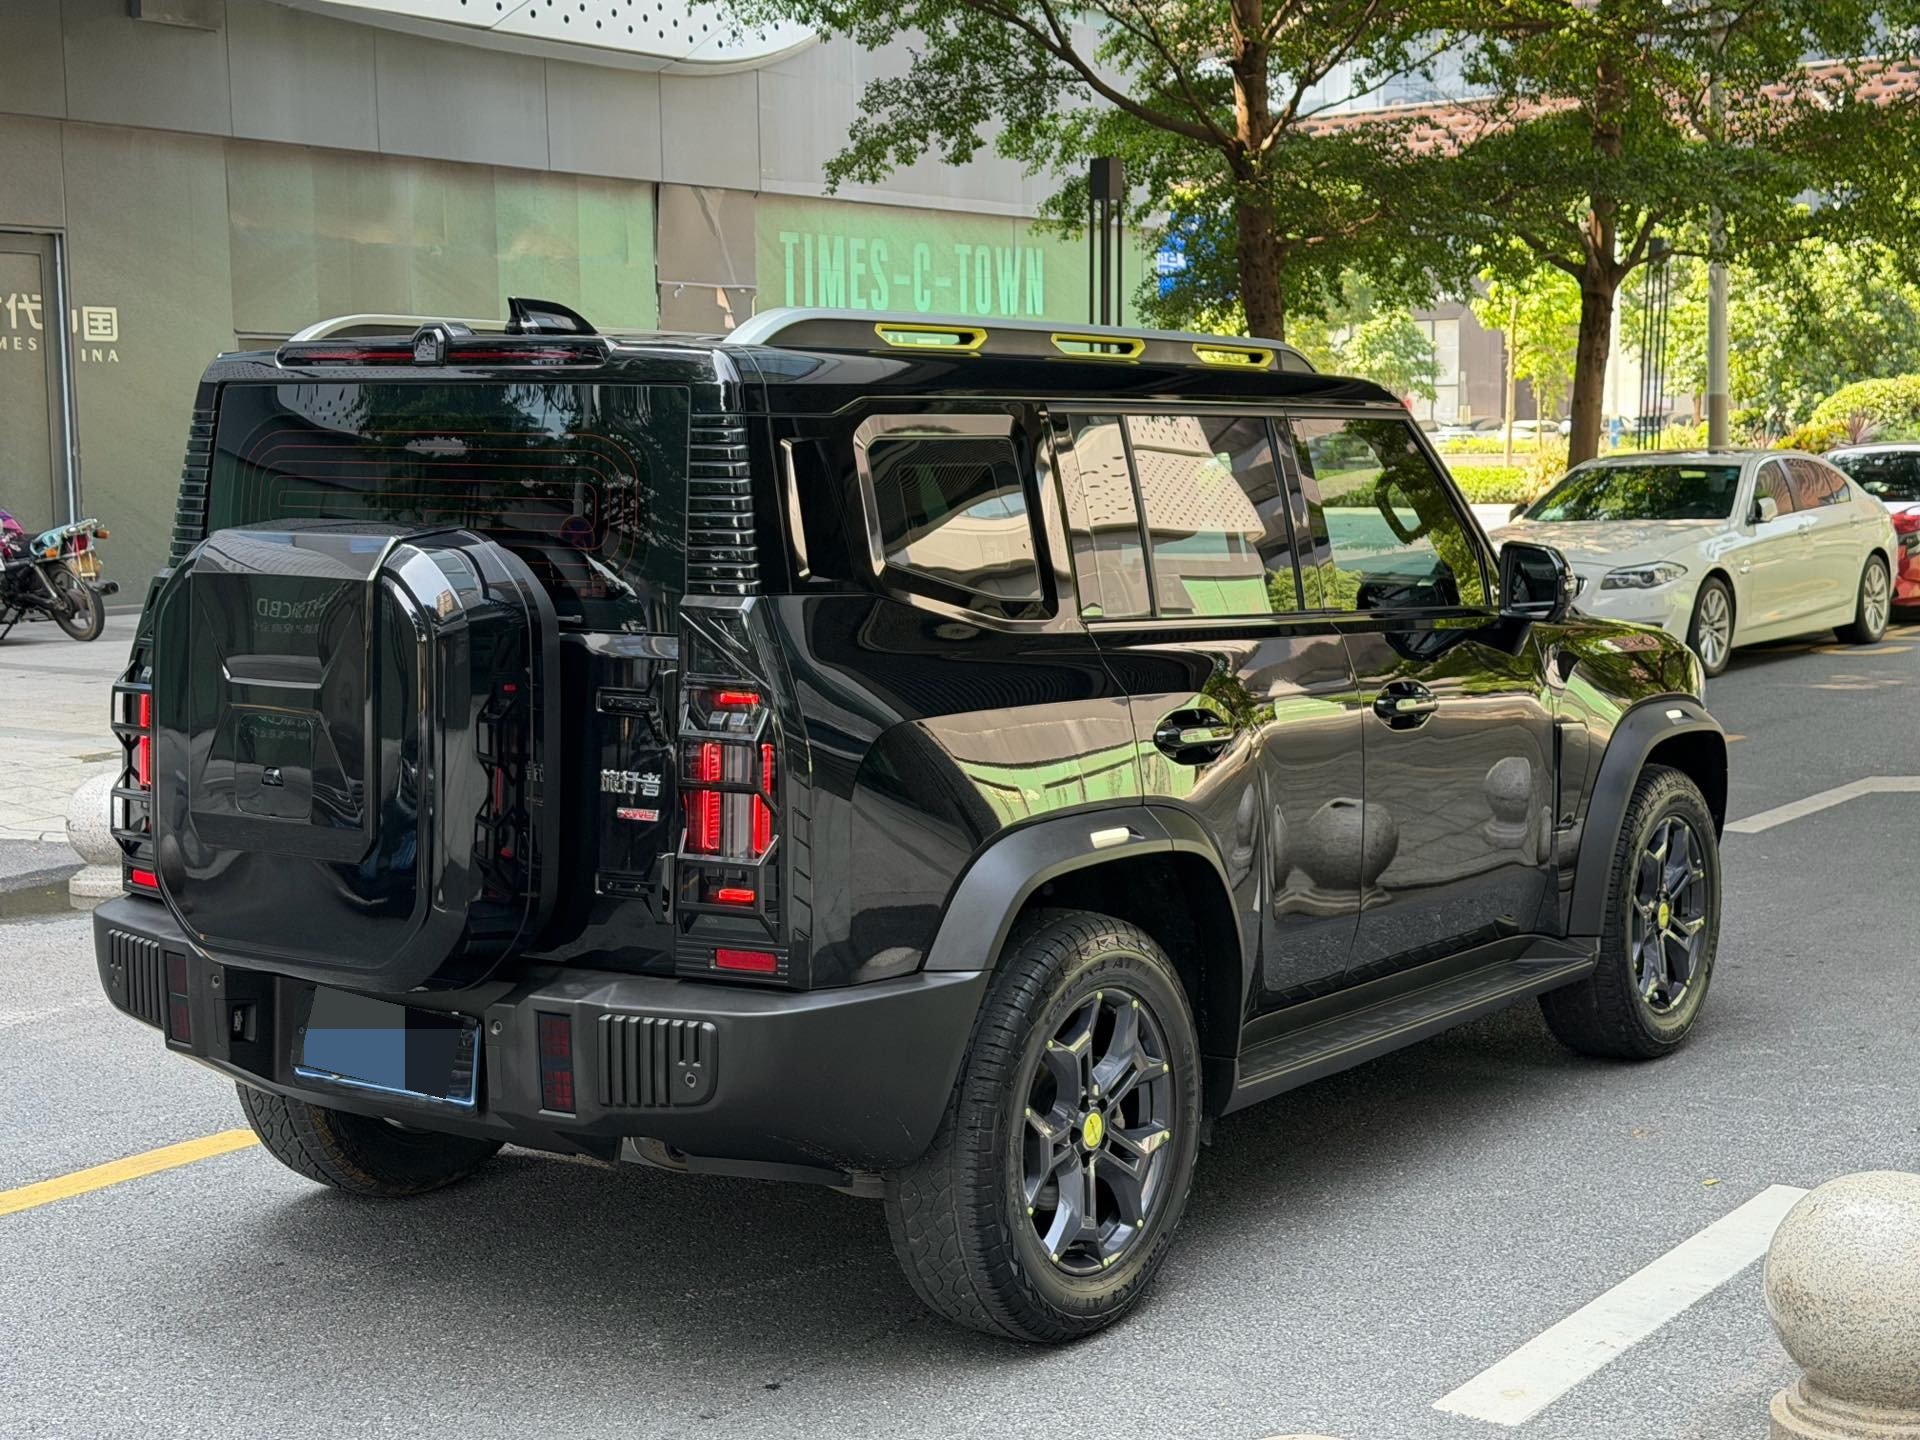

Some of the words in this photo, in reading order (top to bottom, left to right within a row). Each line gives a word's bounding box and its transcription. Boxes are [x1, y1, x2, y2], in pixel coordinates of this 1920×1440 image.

[779, 231, 1044, 316] TIMES-C-TOWN
[0, 293, 43, 330] 代
[71, 306, 118, 342] 国
